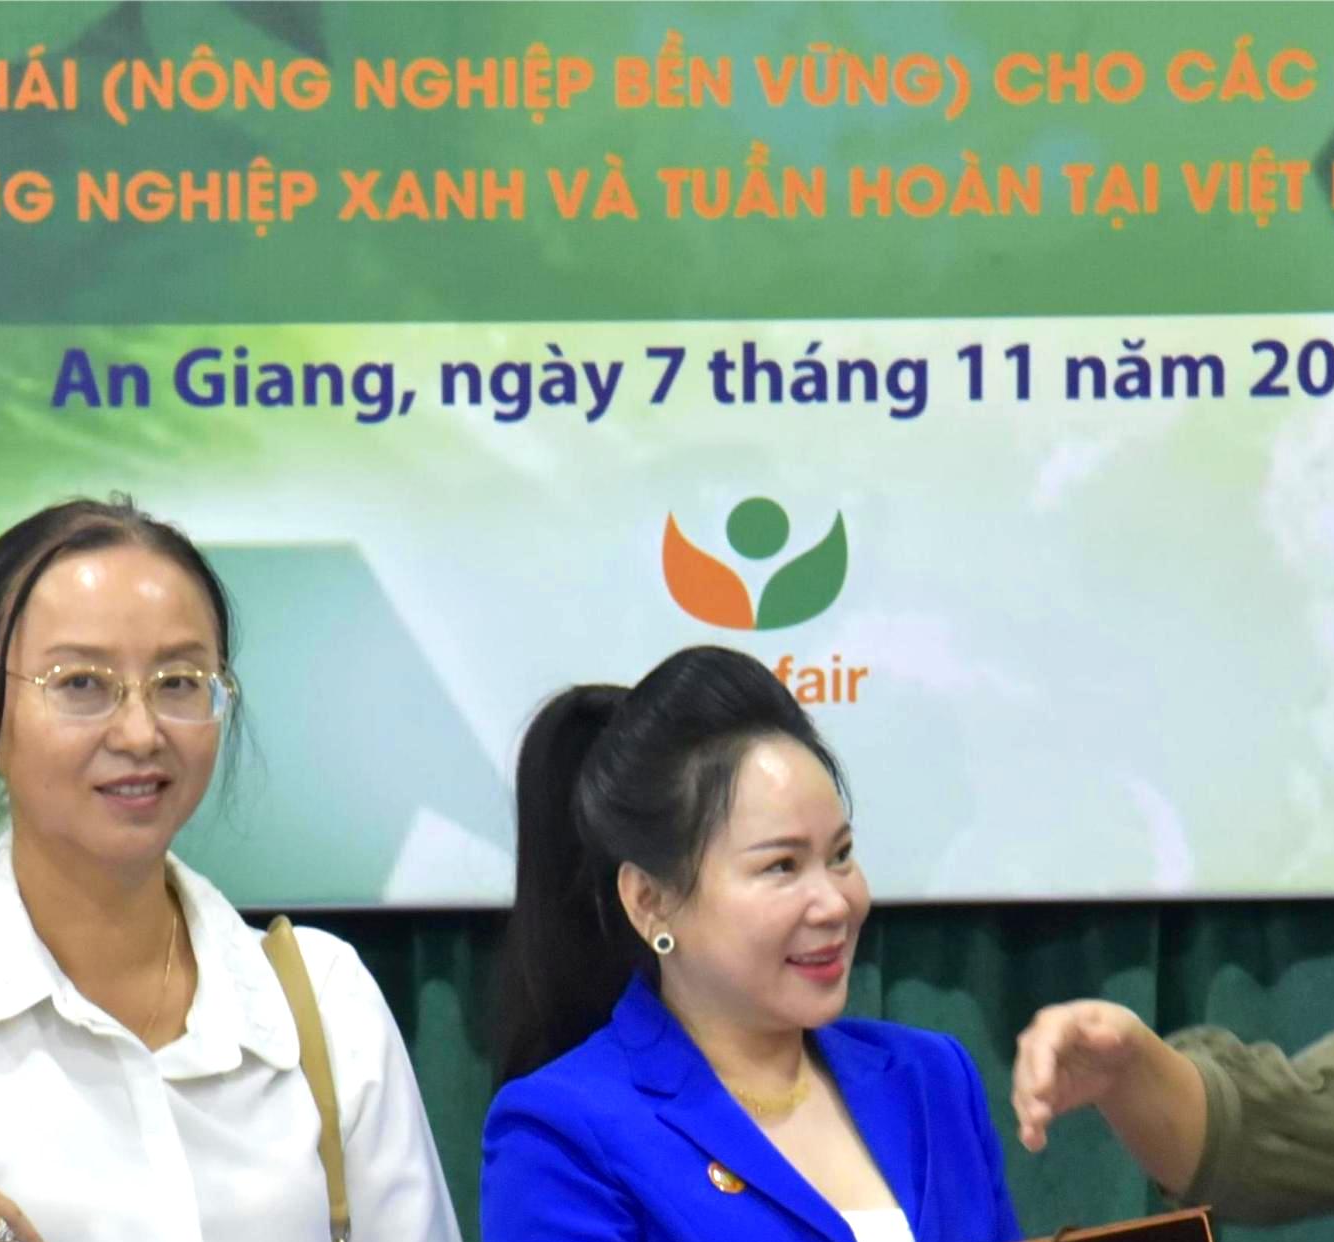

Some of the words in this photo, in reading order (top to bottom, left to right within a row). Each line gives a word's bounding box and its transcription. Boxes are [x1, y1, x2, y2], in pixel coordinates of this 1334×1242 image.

[102, 44, 331, 125] (NÔNG
[355, 43, 594, 123] NGHIỆP
[615, 29, 732, 108] BỀN
[753, 42, 971, 121] VỮNG)
[994, 51, 1145, 104] CHO
[1167, 35, 1315, 103] CÁC
[77, 156, 318, 237] NGHIỆP
[340, 169, 525, 220] XANH
[548, 154, 637, 219] VÀ
[657, 142, 826, 219] TUẦN
[850, 151, 1041, 217] HOÀN
[1063, 163, 1159, 229] TẠI
[1182, 147, 1310, 226] VIỆT
[52, 347, 150, 408] An
[174, 346, 416, 424] Giang,
[440, 343, 623, 424] ngày
[647, 347, 685, 403] 7
[708, 341, 929, 419] tháng
[956, 344, 1031, 400] 11
[1065, 340, 1225, 399] năm
[771, 655, 869, 704] fair
